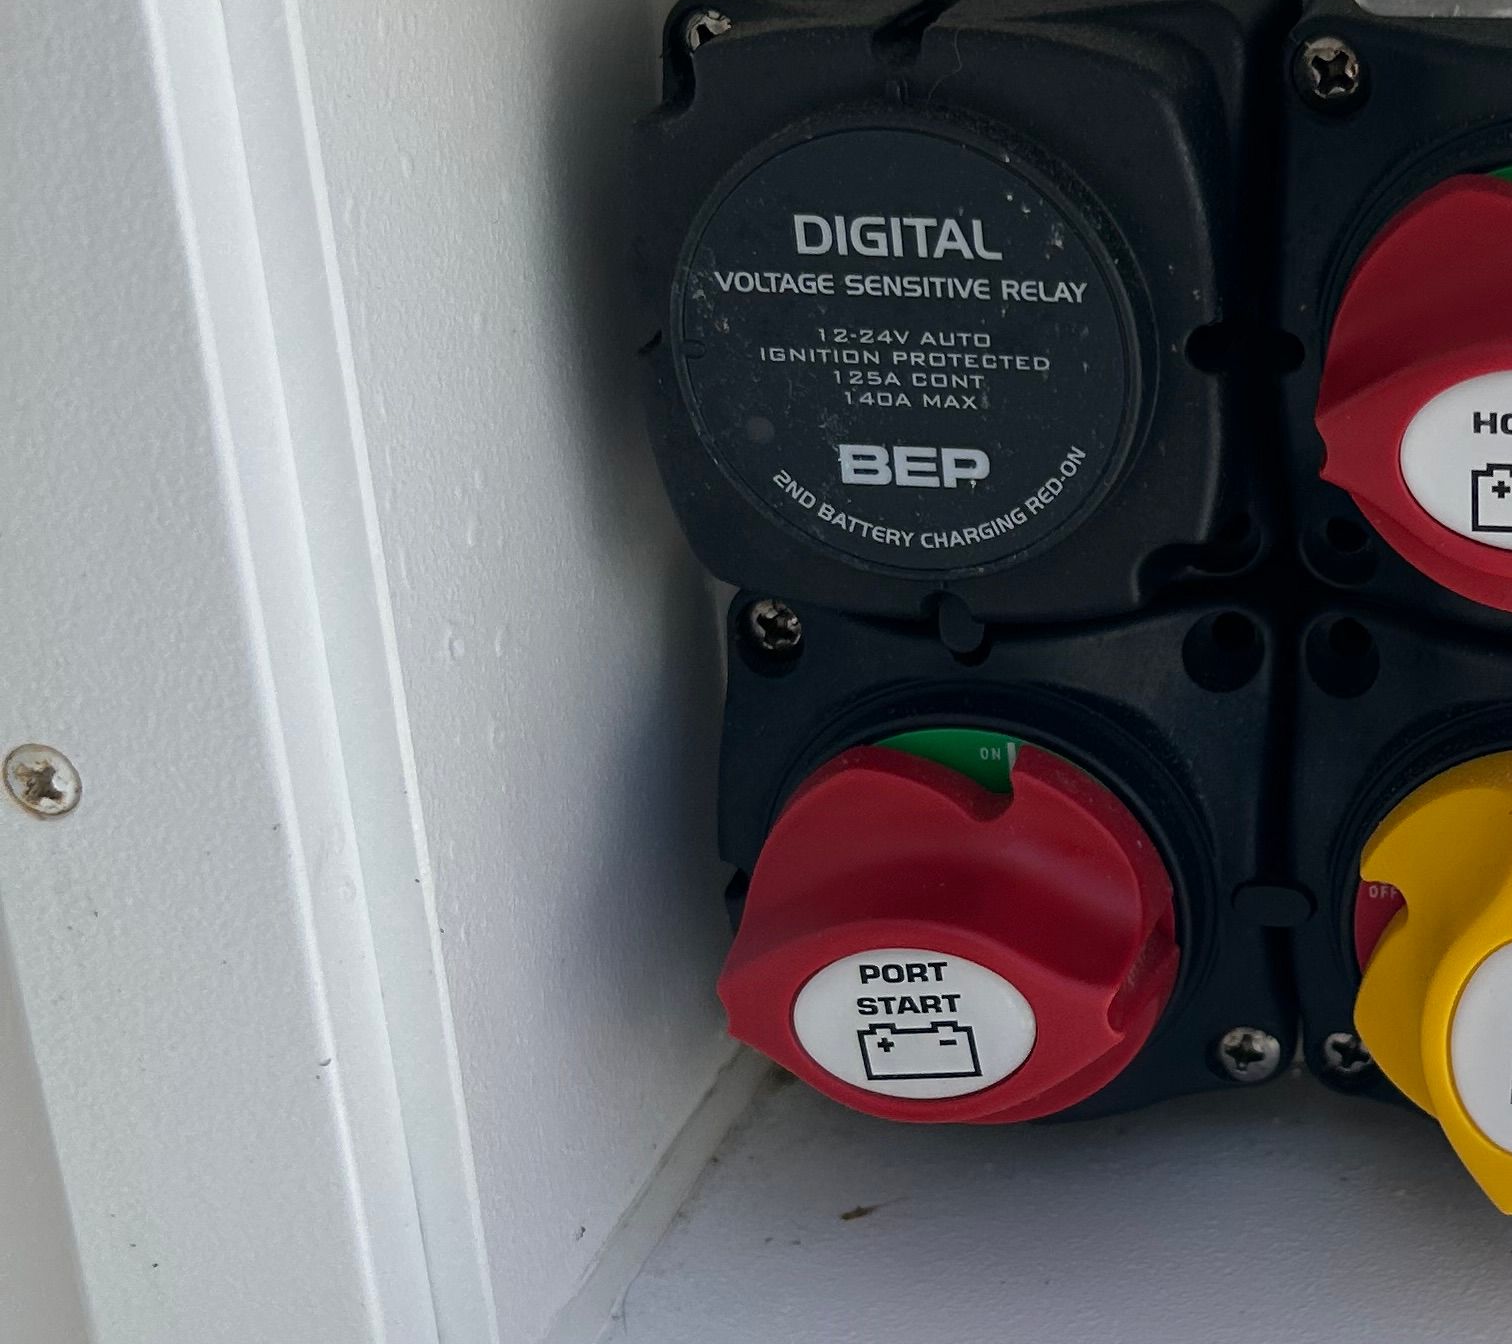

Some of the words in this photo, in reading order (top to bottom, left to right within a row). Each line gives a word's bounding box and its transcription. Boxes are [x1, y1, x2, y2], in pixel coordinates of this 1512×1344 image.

[794, 214, 1002, 260] DIGITAL
[715, 271, 835, 296] VOLTAGE
[846, 275, 990, 300] SENSITIVE
[1002, 279, 1087, 304] RELAY
[818, 328, 910, 346] 12-24V
[920, 331, 991, 348] AUTO
[760, 348, 880, 365] IGNITION
[893, 352, 1050, 371] PROTECTED
[834, 370, 901, 387] 125A
[912, 373, 985, 389] CONT
[844, 391, 911, 408] 140A
[923, 393, 978, 410] MAX
[839, 444, 990, 489] BEP
[773, 469, 816, 511] 2ND
[818, 503, 914, 548] BATTERY
[921, 508, 1027, 549] CHARGING
[1025, 446, 1086, 516] RED-ON
[980, 747, 1001, 760] ON
[860, 962, 947, 984] PORT
[857, 994, 960, 1015] START
